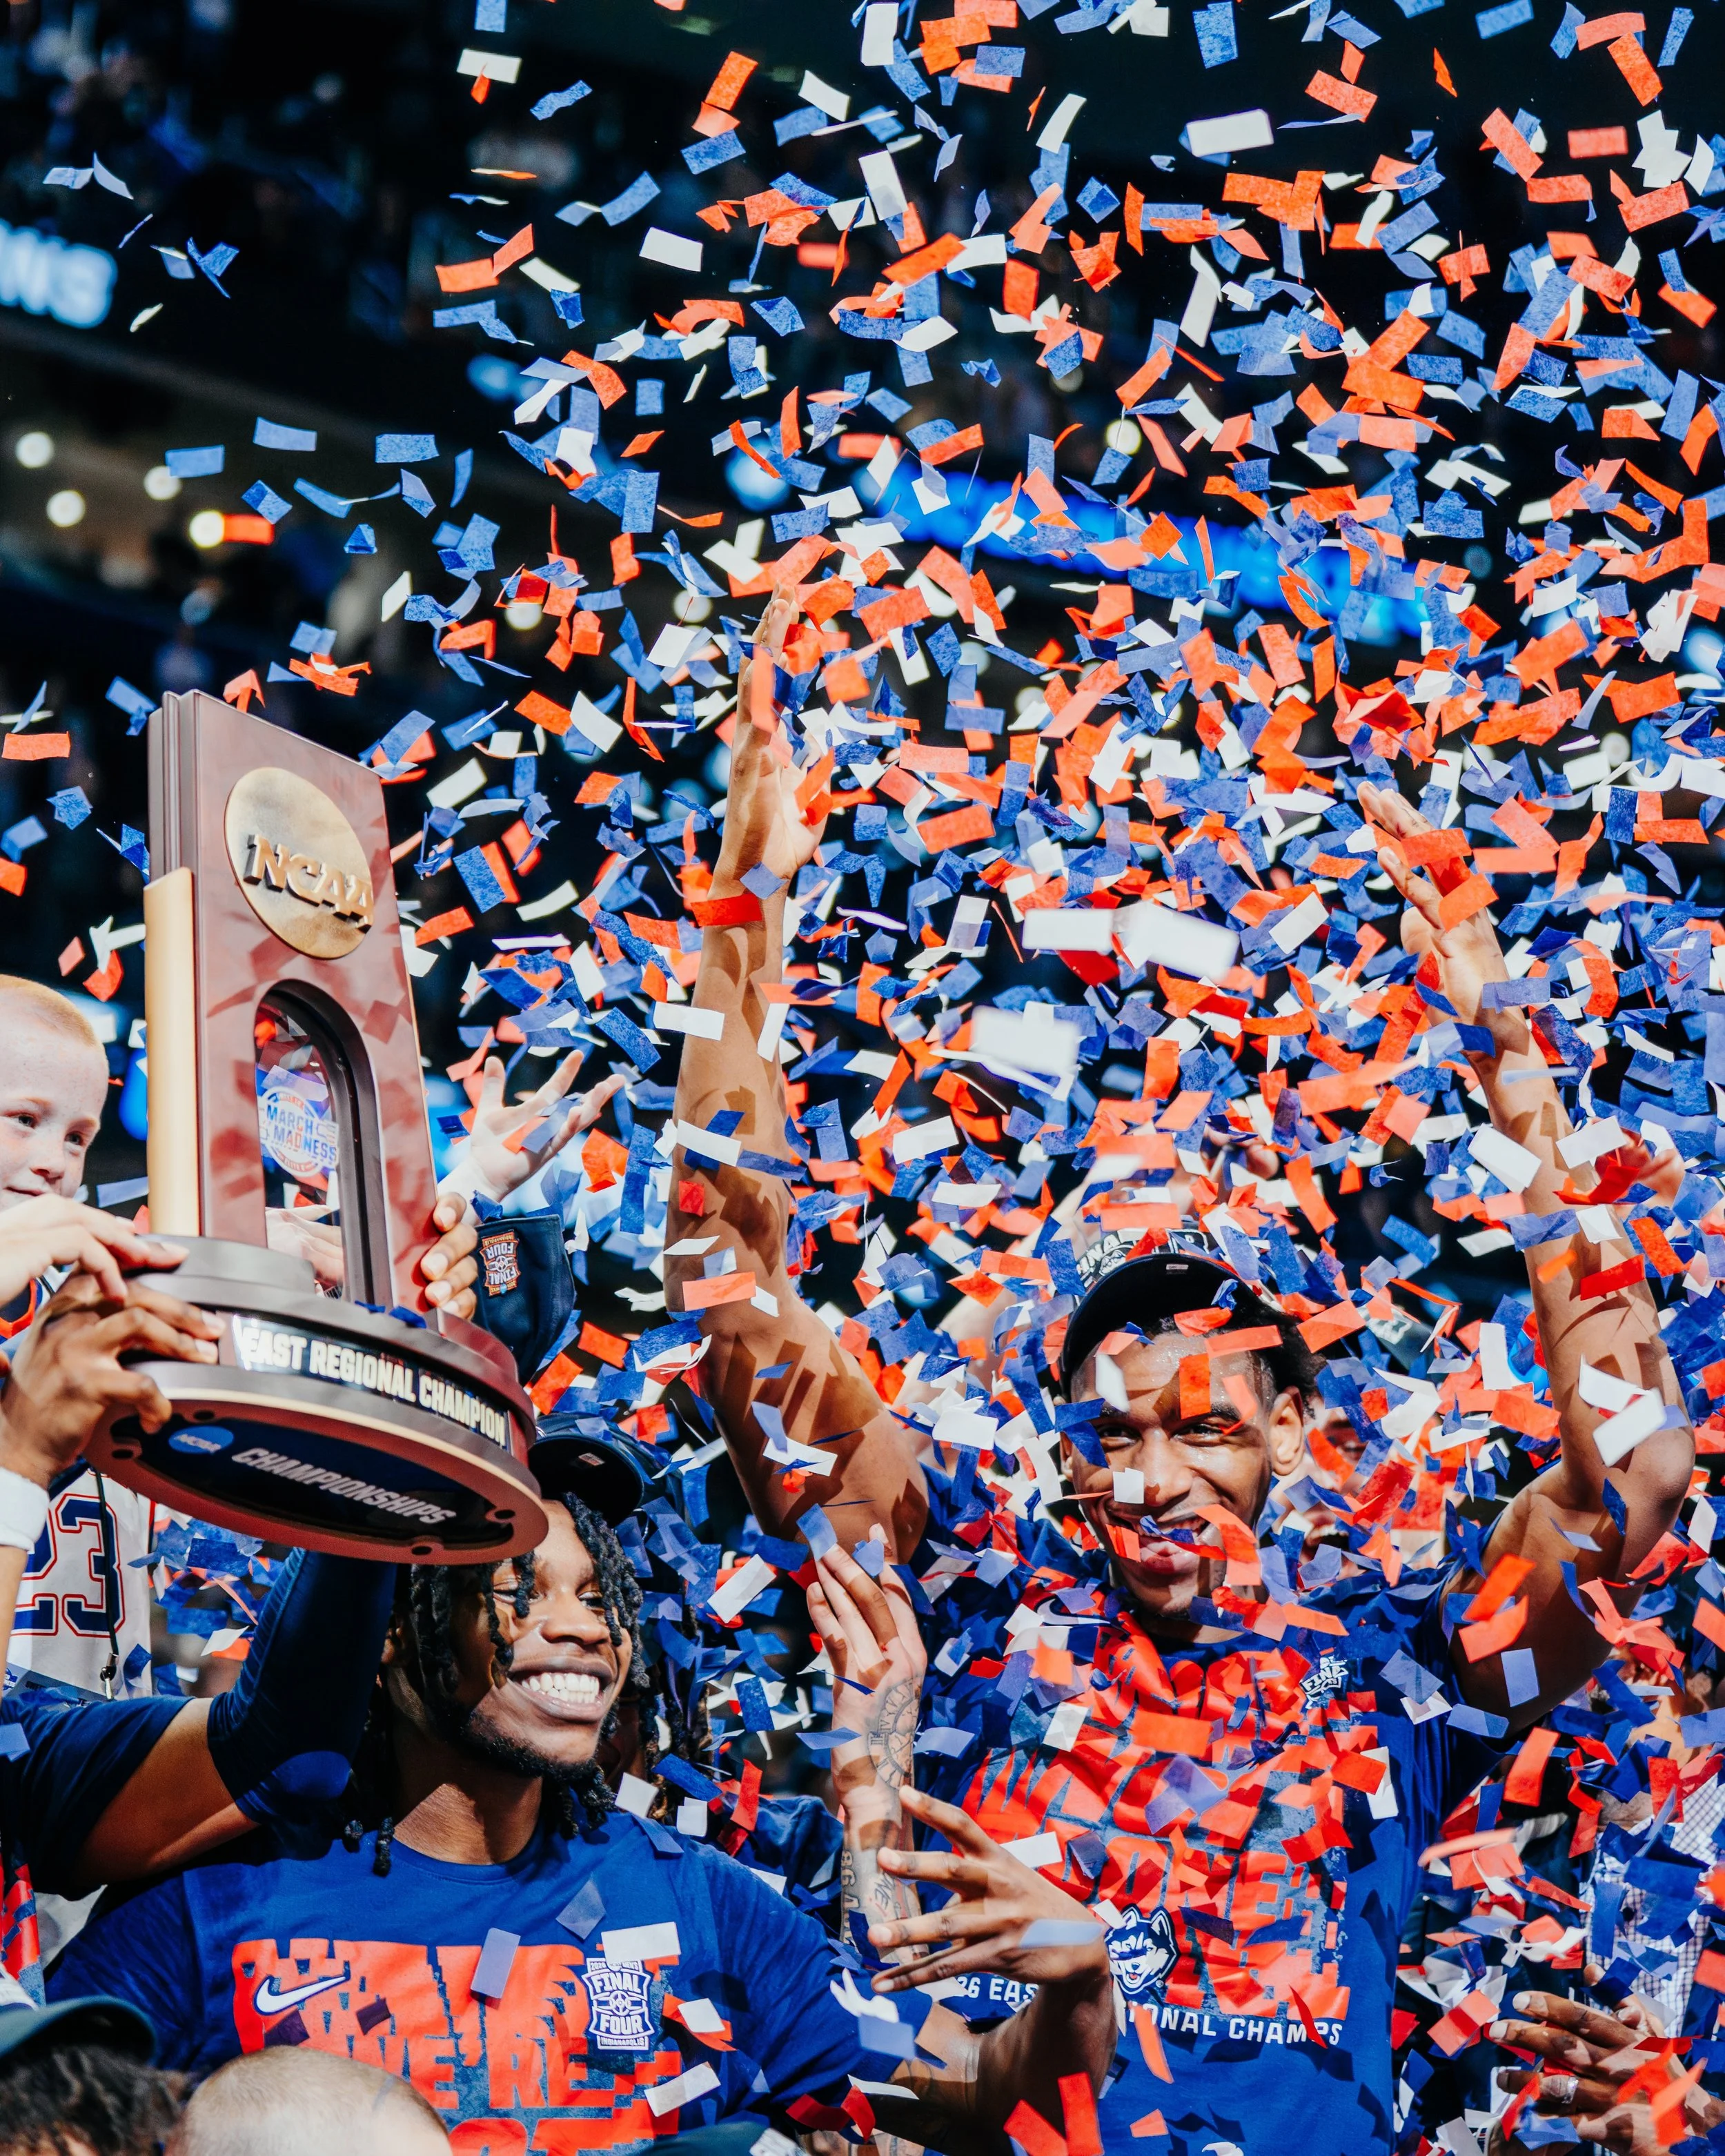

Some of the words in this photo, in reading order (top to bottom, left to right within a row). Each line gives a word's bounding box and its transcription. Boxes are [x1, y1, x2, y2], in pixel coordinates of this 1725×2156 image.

[244, 834, 374, 933] NCAA
[266, 1105, 313, 1135] MARCH
[274, 1125, 337, 1163] MADNESS
[485, 1243, 514, 1259] FOUR
[489, 1267, 517, 1285] FINAL
[242, 1325, 307, 1370] EAST
[309, 1340, 416, 1402] REGIONAL
[419, 1374, 506, 1447] CHAMPION
[231, 1448, 457, 1524] CHAMPIONSHIPS
[591, 1972, 642, 1993] FINAL
[600, 2013, 644, 2035] FOUR
[989, 1978, 1039, 2003] EAS
[1228, 2018, 1343, 2046] CHAMPS
[600, 2037, 645, 2047] INDIANAPOLIS
